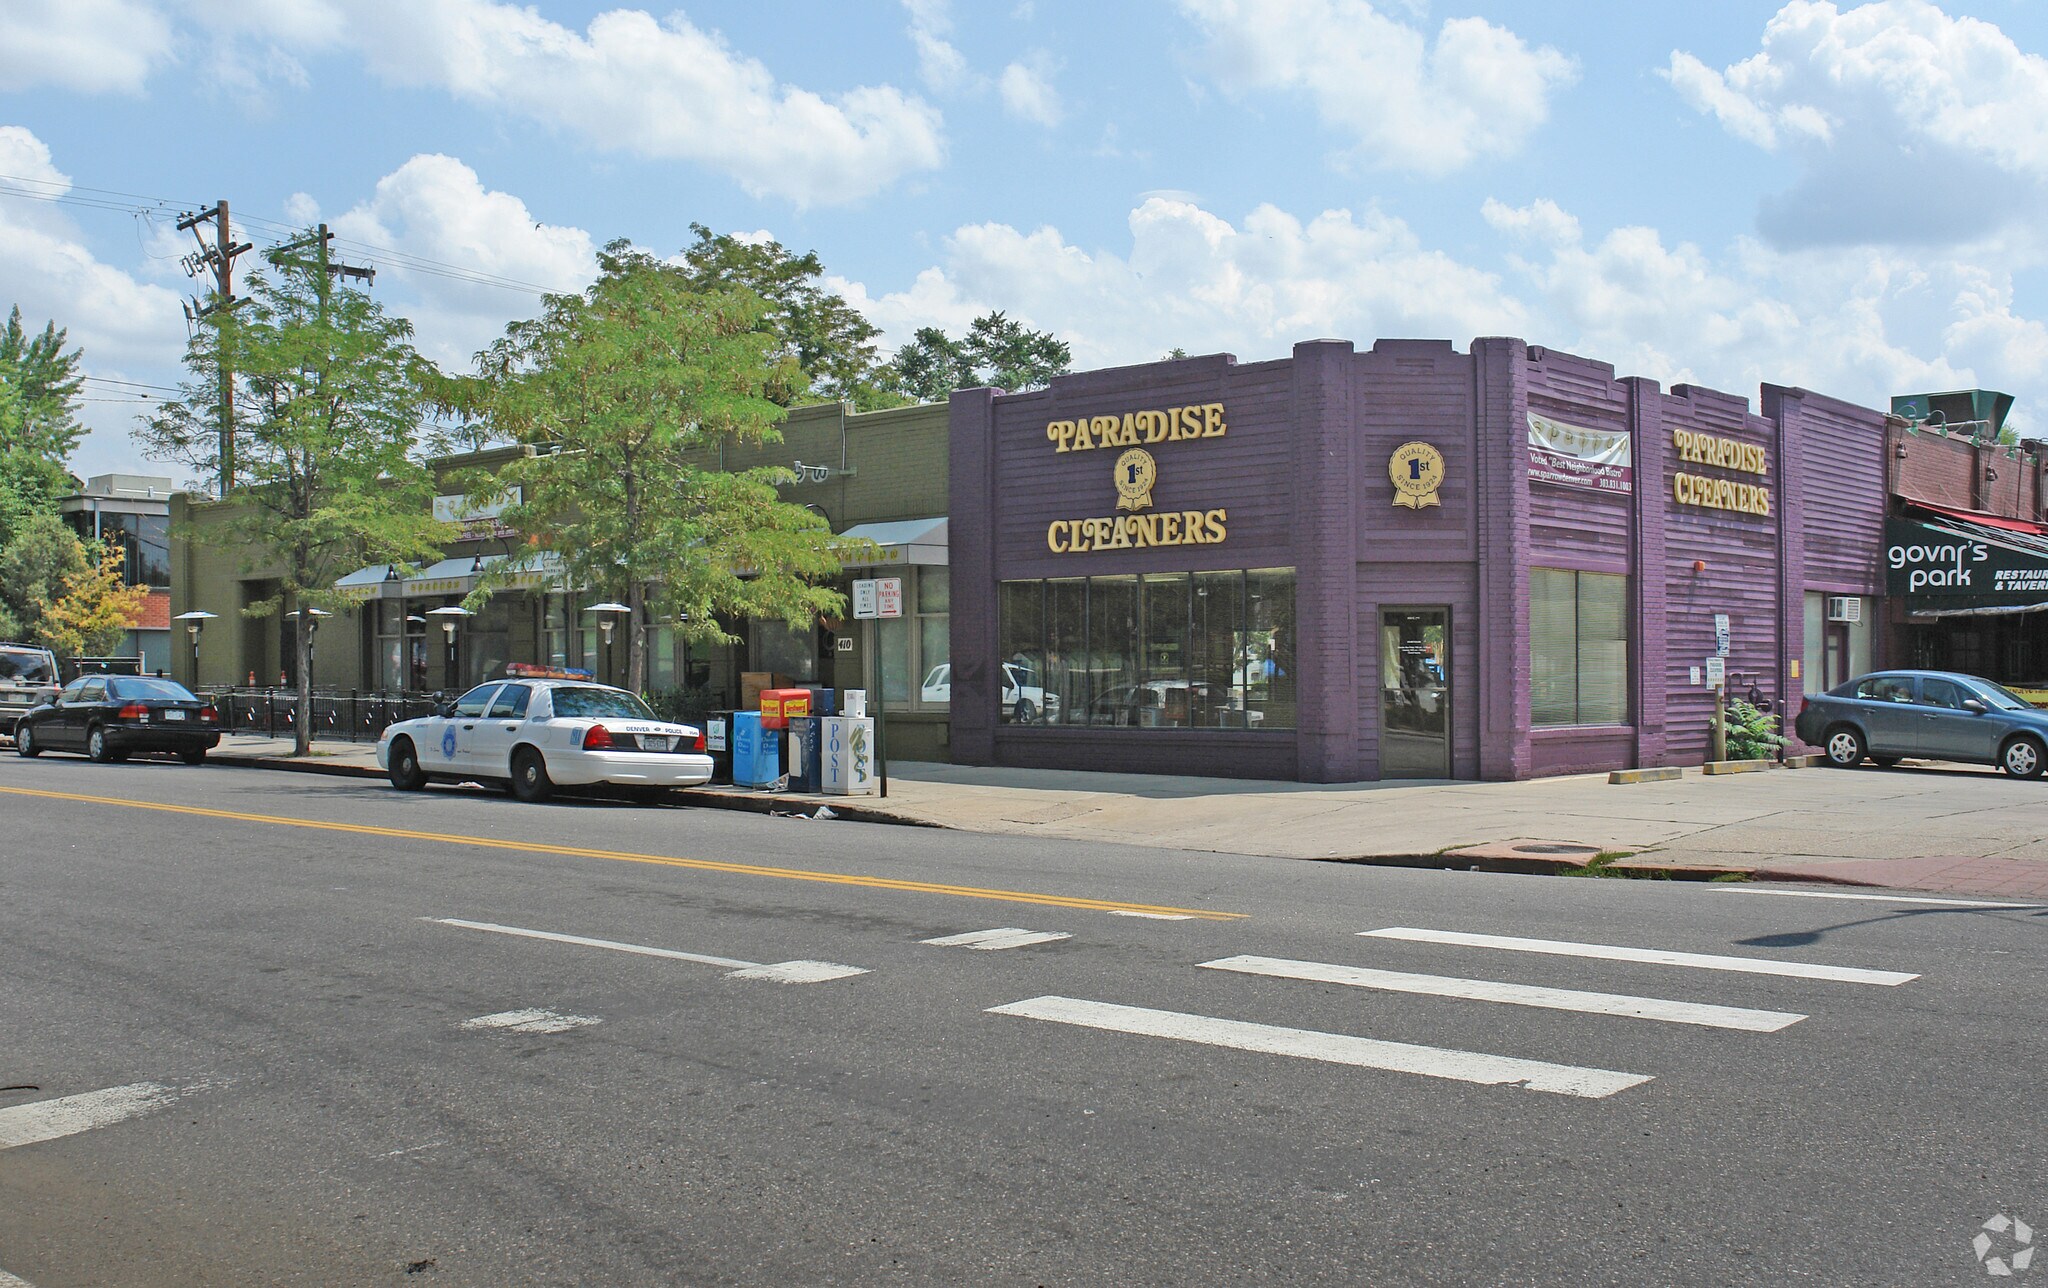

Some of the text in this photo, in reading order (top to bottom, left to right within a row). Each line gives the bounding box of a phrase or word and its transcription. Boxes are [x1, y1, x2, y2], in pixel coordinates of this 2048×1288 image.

[1046, 402, 1227, 453] PARADISE
[1121, 453, 1147, 467] QUALITY
[1399, 447, 1436, 461] QUALITY
[1673, 428, 1767, 475] PARADISE
[1127, 463, 1144, 484] 1st
[1408, 458, 1431, 480] 1st
[1530, 452, 1624, 478] Voted "Best Neighborhood Bistro"
[1119, 478, 1149, 493] SINCE 1924
[1396, 474, 1438, 490] SINCE 1924
[1674, 471, 1770, 516] CLEANERS
[1047, 508, 1227, 554] CLEANERS
[1888, 540, 1988, 570] govnr's
[1909, 567, 1972, 593] park
[1994, 581, 2004, 591] &
[839, 639, 851, 650] 410
[830, 723, 840, 783] POST
